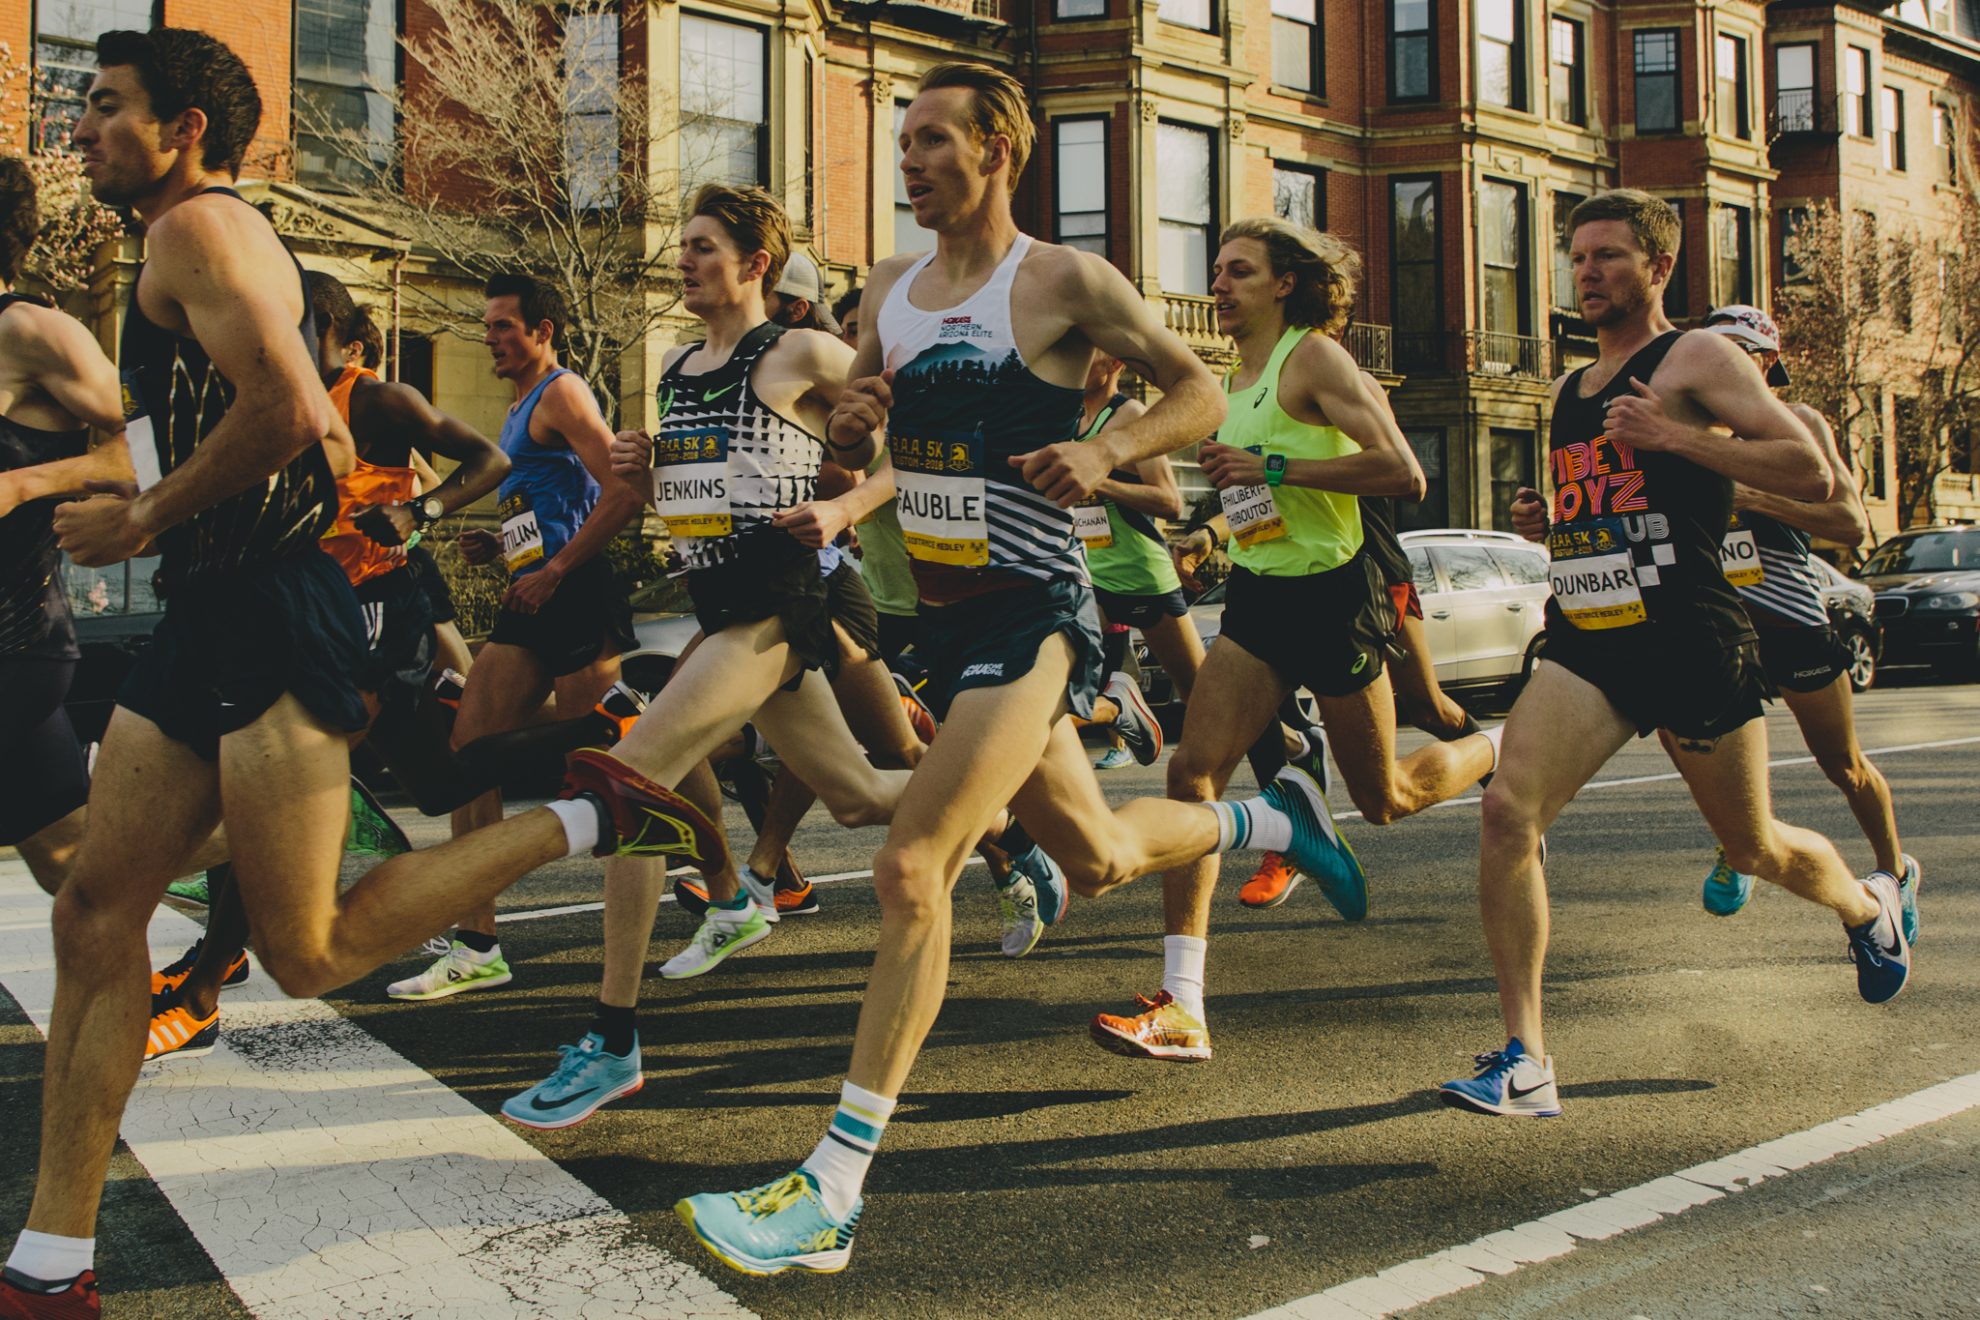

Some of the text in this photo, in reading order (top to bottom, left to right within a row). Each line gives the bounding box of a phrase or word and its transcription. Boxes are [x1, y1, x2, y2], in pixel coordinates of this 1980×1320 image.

[939, 330, 993, 338] ARIZONA ELITE
[941, 323, 982, 332] NORTHERN
[683, 436, 701, 450] 5K
[926, 440, 944, 458] 5K
[895, 456, 920, 468] OSTON
[656, 478, 726, 502] JENKINS
[1226, 500, 1273, 527] THIBOUTOT
[1073, 515, 1107, 527] UCHANAN
[1621, 513, 1670, 543] UB
[1573, 531, 1591, 545] 5K
[936, 542, 965, 552] MEDLEY
[1553, 569, 1633, 596] DUNBAR
